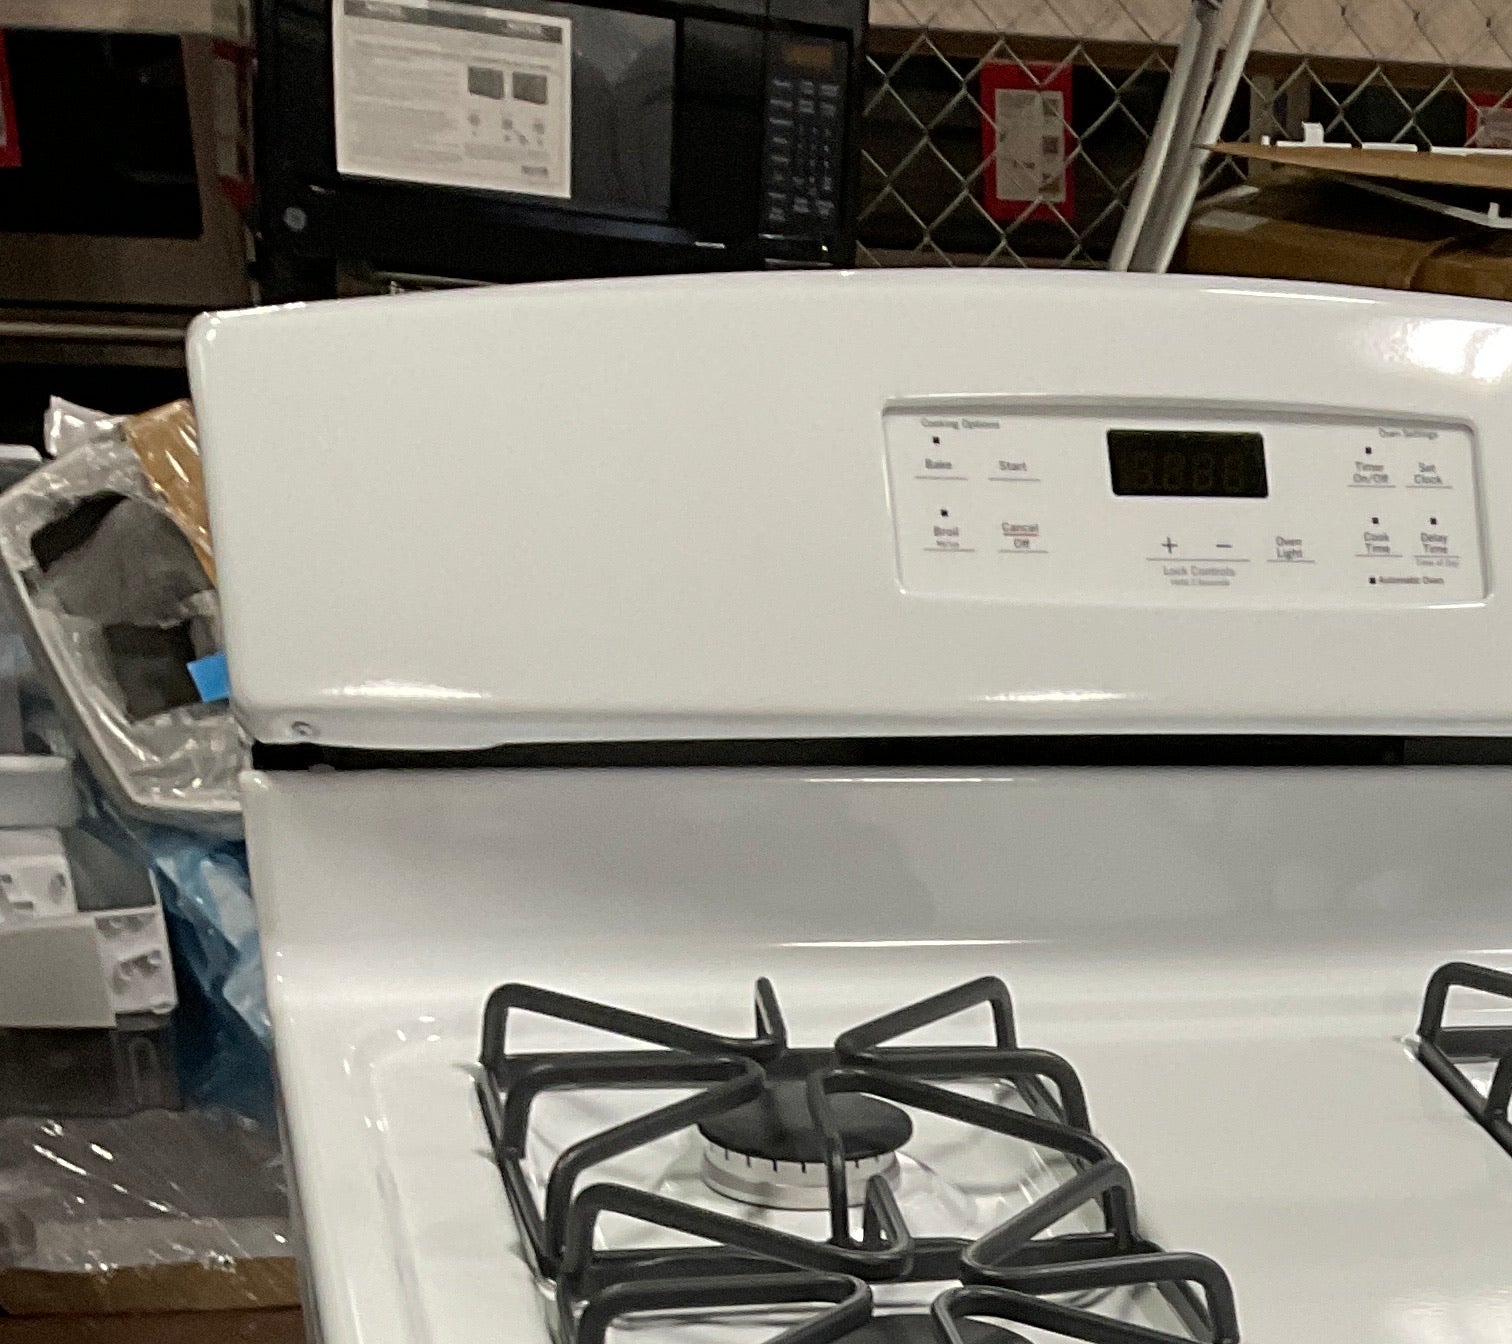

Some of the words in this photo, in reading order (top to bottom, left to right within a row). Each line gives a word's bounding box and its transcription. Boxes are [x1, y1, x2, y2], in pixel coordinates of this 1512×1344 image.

[999, 460, 1027, 471] Start
[933, 525, 959, 536] Broil
[1001, 522, 1039, 532] Cancel
[1013, 538, 1030, 548] Off
[1276, 548, 1303, 560] Light
